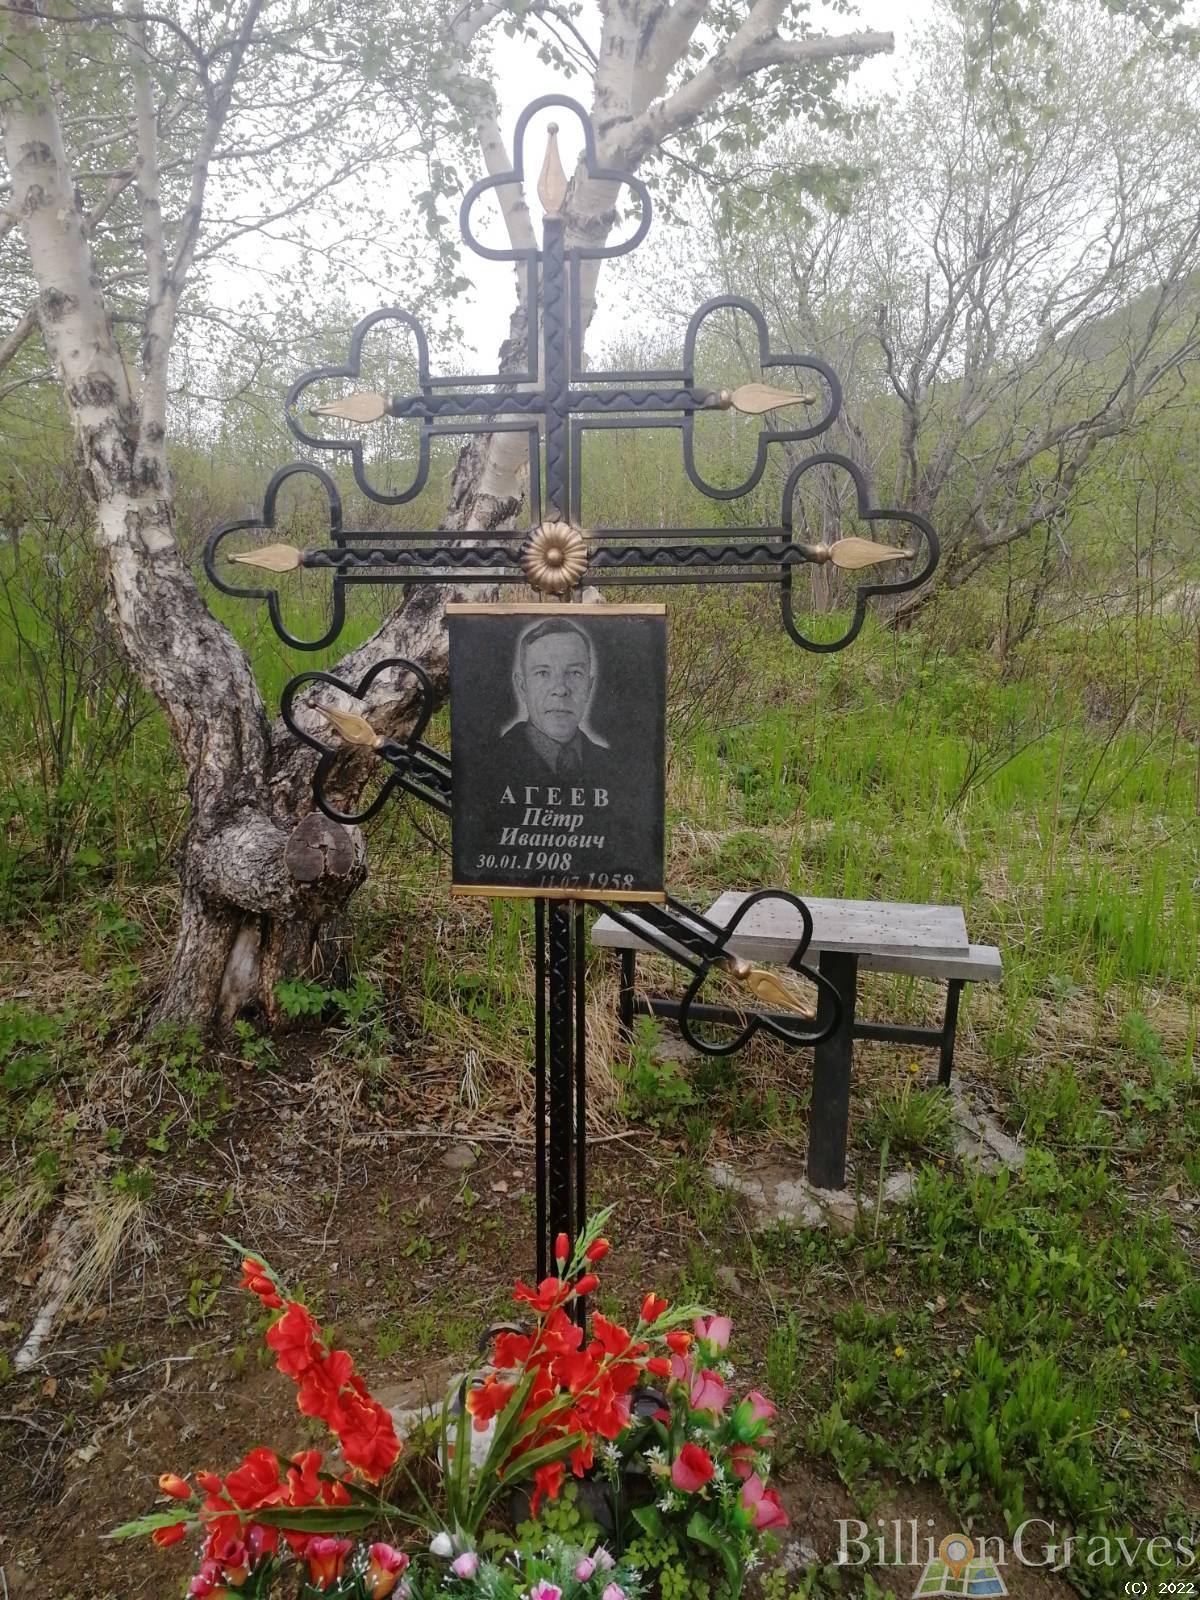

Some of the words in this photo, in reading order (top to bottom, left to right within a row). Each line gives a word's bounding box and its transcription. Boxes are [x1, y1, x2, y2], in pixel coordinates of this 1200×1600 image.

[500, 785, 609, 807] АГЕЕВ
[522, 807, 584, 832] Пётр
[499, 827, 605, 849] Иванович
[476, 851, 572, 871] 30.01.1908
